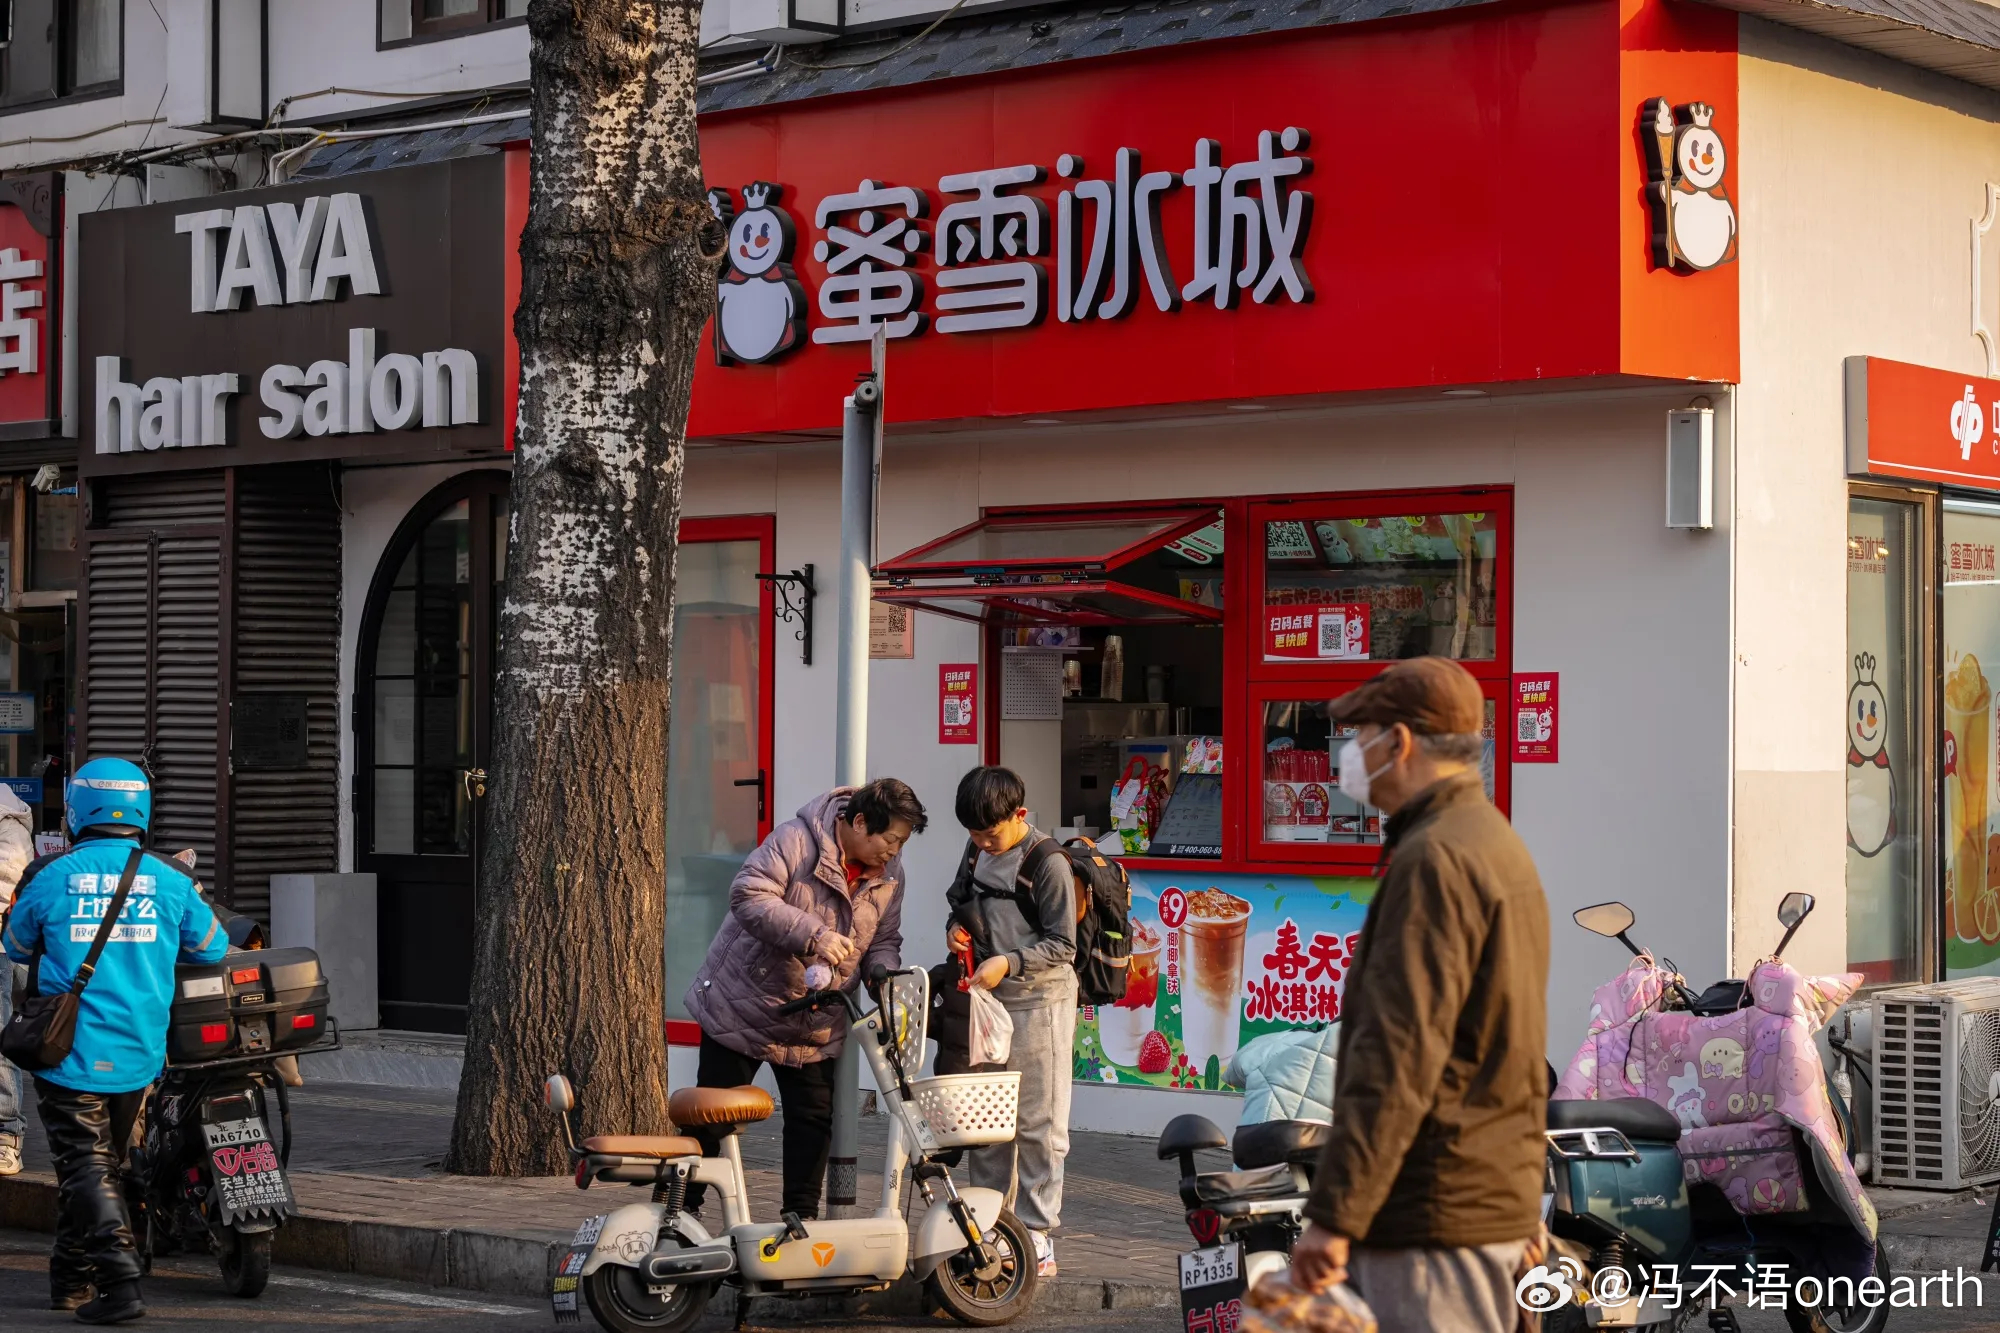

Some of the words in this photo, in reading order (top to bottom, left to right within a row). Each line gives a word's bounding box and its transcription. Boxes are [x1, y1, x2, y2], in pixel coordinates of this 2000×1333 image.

[813, 126, 1314, 344] 蜜雪冰城
[175, 192, 380, 312] TAYA
[96, 356, 239, 454] hair
[259, 327, 479, 440] salon
[1950, 542, 1995, 571] 蜜雪冰城
[1270, 614, 1314, 632] 扫码点餐
[1274, 632, 1308, 648] 更快哦
[1519, 681, 1551, 693] 扫码点餐
[1168, 892, 1184, 923] 9
[1166, 931, 1179, 995] 椰椰拿铁
[1246, 974, 1339, 1021] 冰淇淋
[209, 1128, 261, 1145] NA6710
[221, 1169, 283, 1192] 天竺总代理
[1194, 1250, 1225, 1267] 北京
[1184, 1261, 1234, 1286] RP1335
